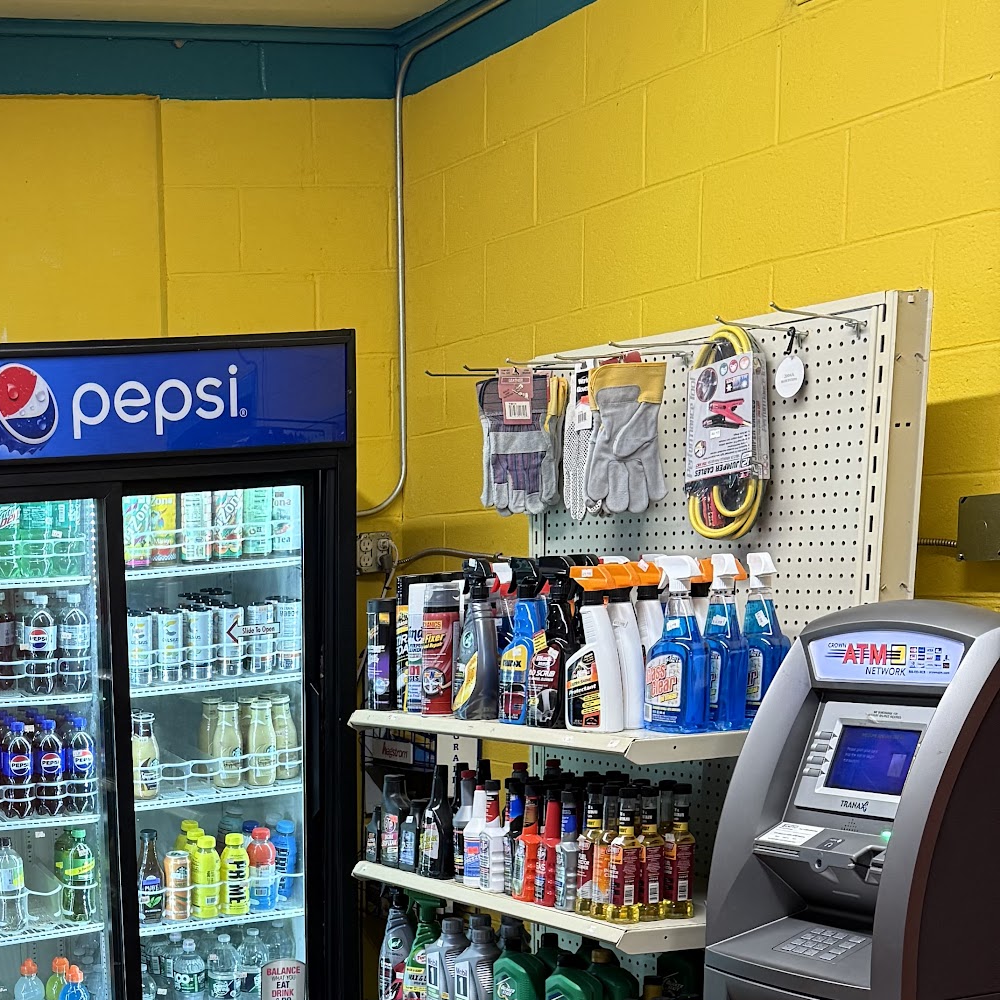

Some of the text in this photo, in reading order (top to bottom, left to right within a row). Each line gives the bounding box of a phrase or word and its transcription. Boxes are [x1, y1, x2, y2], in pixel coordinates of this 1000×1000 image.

[73, 364, 239, 439] pepsi
[694, 460, 740, 477] JUMPER CABLES
[262, 625, 275, 634] Open
[842, 643, 888, 666] ATM
[865, 666, 907, 676] NETWORK
[568, 683, 597, 696] Protectant
[381, 741, 408, 759] hagstrom
[11, 761, 30, 769] PEPSI
[41, 759, 60, 767] PEPSI
[228, 860, 247, 905] PRME
[266, 966, 301, 976] BALANCE
[456, 967, 468, 977] Mobil
[276, 981, 290, 989] EAT
[271, 989, 294, 997] DRINK
